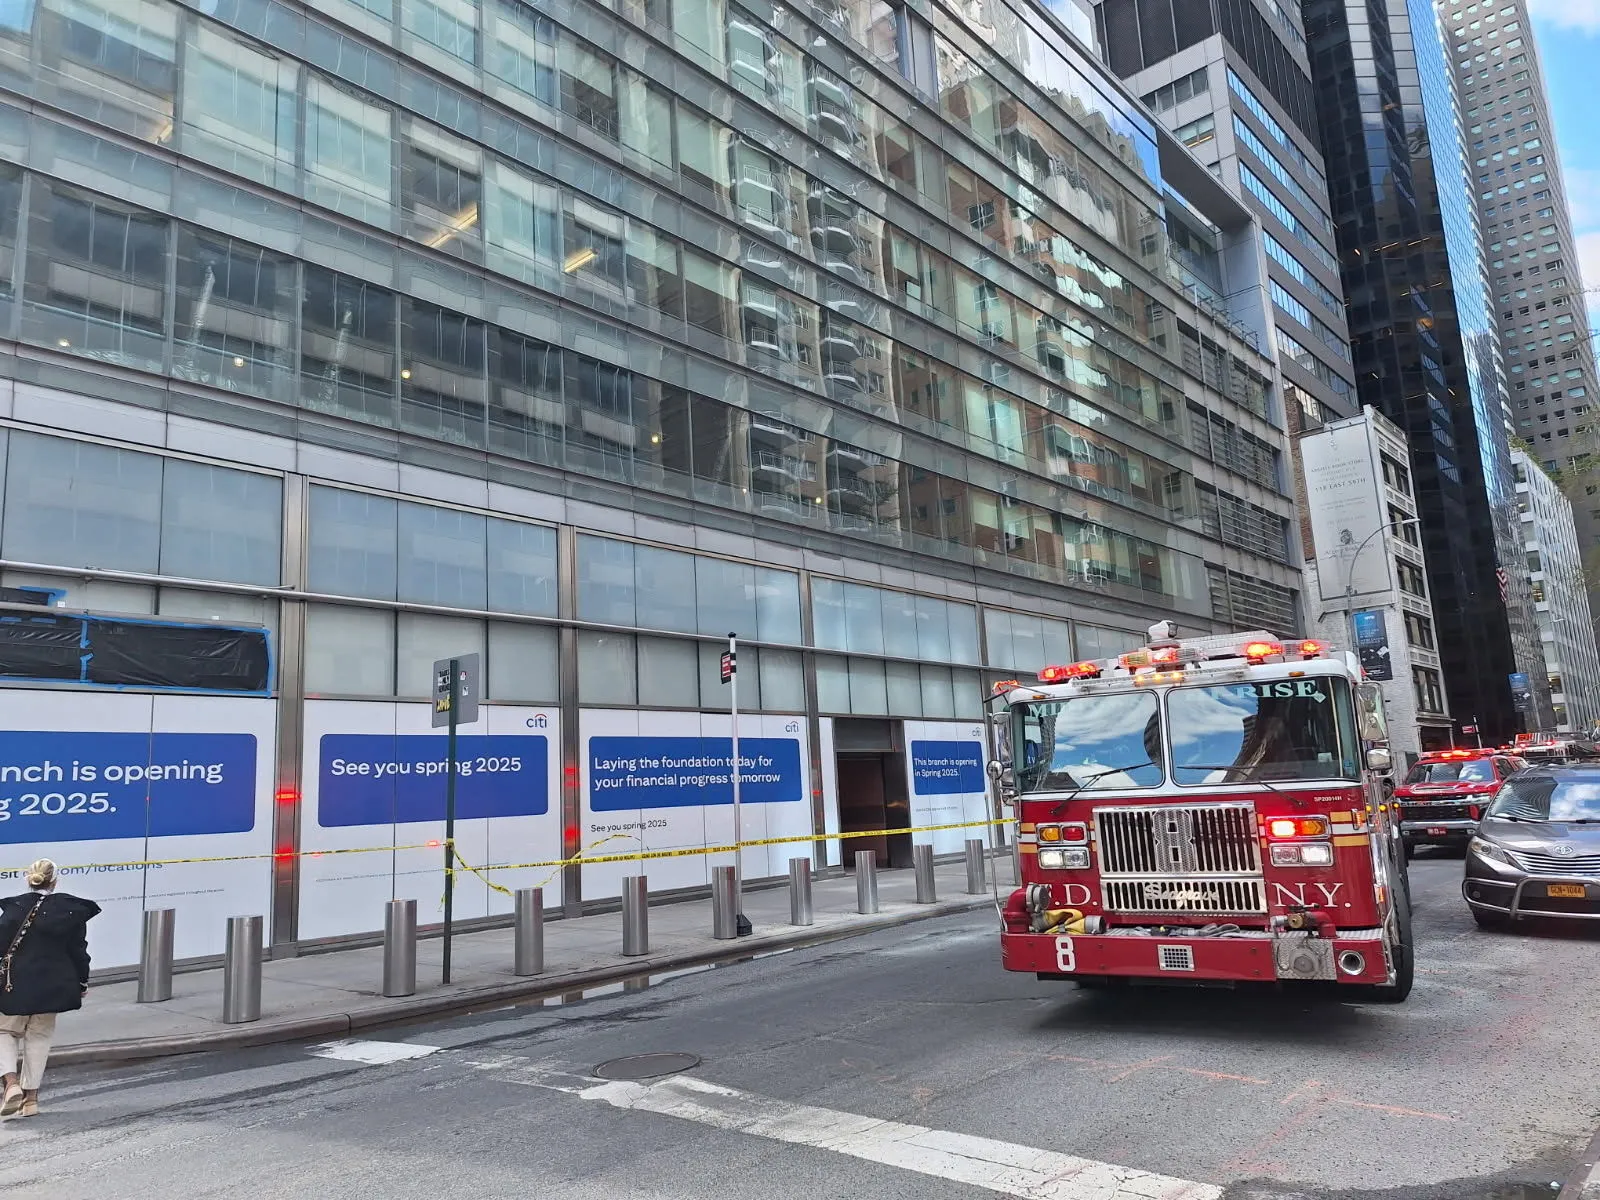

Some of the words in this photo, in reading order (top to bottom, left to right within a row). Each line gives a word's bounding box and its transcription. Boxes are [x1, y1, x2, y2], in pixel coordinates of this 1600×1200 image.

[526, 714, 547, 728] citi
[785, 721, 799, 733] citi
[331, 759, 370, 776] See
[374, 762, 411, 779] you
[415, 758, 472, 777] spring
[476, 757, 522, 773] 2025
[594, 757, 637, 772] Laying
[639, 757, 659, 769] the
[661, 756, 722, 768] foundation
[759, 755, 773, 767] for
[914, 758, 926, 766] This
[928, 757, 948, 766] branch
[950, 757, 954, 765] is
[955, 758, 977, 767] opening
[72, 761, 97, 781] is
[104, 760, 224, 785] opening
[915, 769, 920, 777] in
[921, 768, 941, 778] Spring
[942, 768, 960, 776] 2025.
[595, 777, 623, 791] your
[626, 774, 677, 787] financial
[680, 774, 728, 788] progress
[19, 792, 117, 815] 2025.
[591, 824, 605, 833] See
[607, 823, 621, 832] you
[623, 821, 647, 831] spring
[647, 819, 667, 828] 2025
[1152, 809, 1197, 873] 8
[1055, 936, 1076, 972] 8
